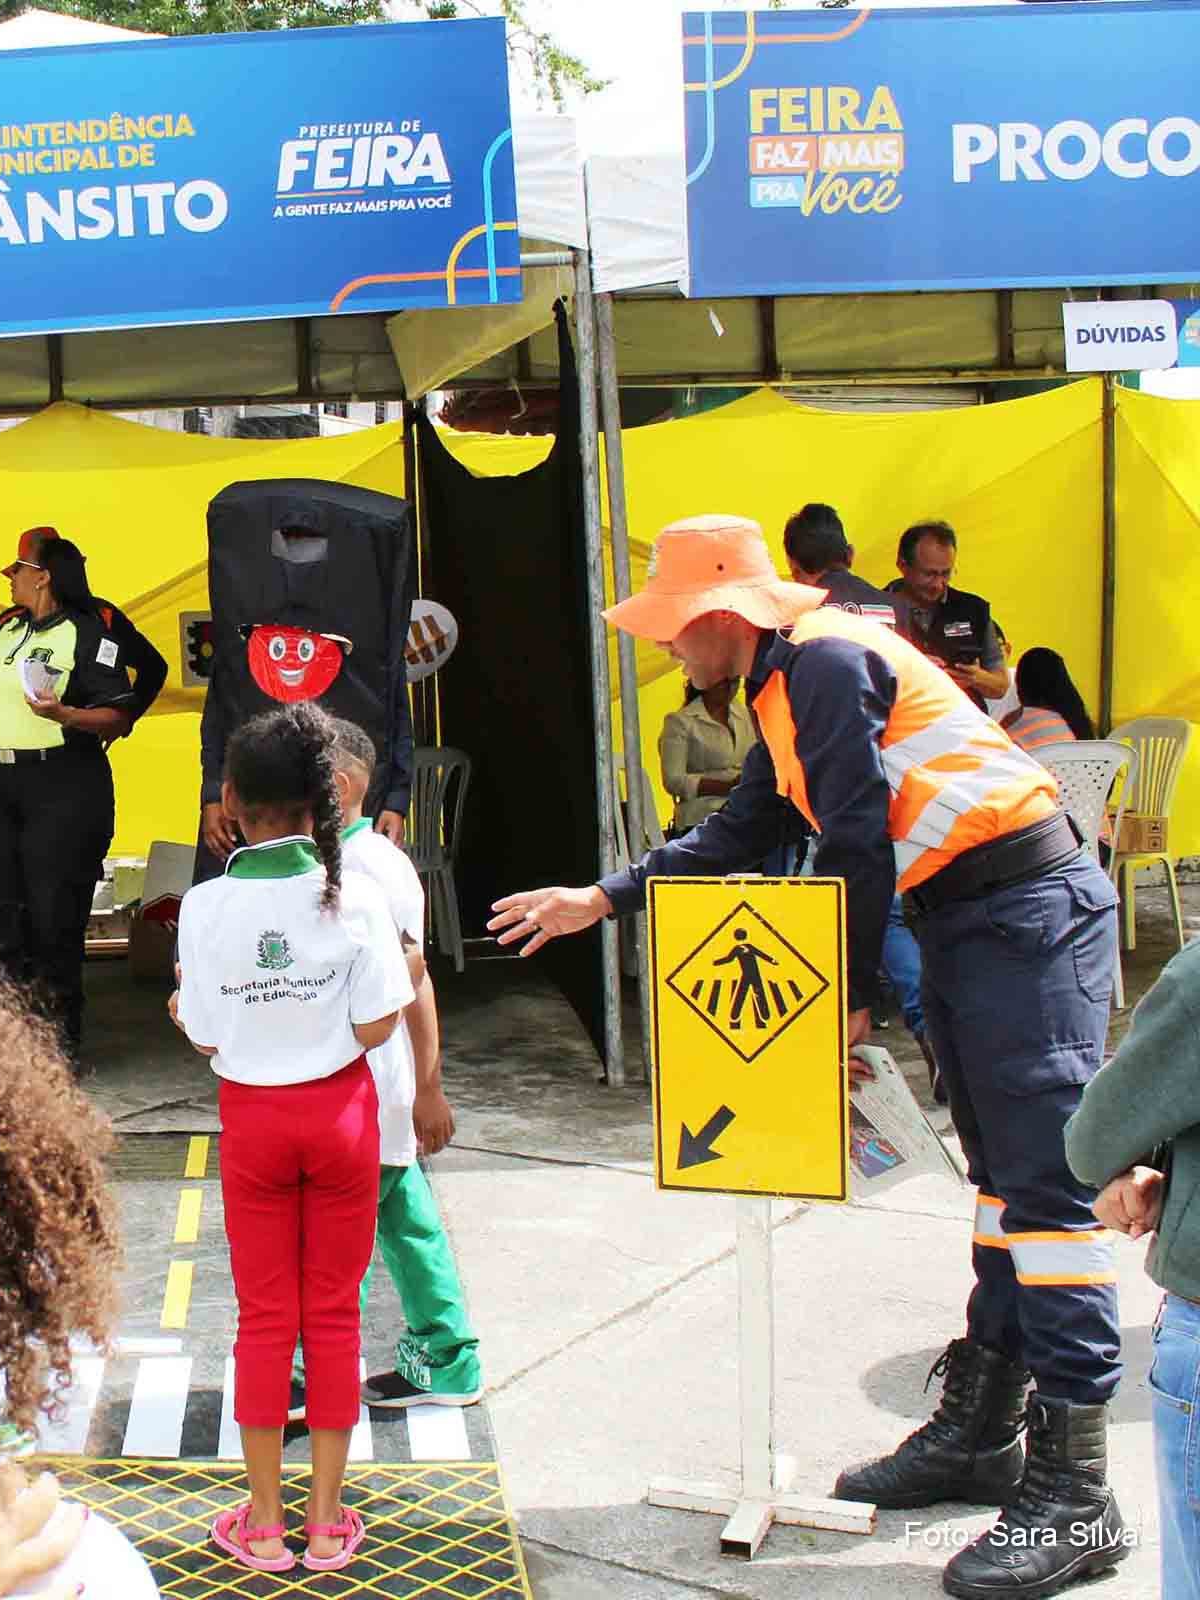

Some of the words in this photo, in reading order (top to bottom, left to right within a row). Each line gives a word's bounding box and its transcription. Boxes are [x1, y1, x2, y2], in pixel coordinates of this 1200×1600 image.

[750, 85, 904, 133] FEIRA
[299, 121, 393, 138] PREFEITURA
[401, 120, 421, 133] DE
[117, 144, 155, 168] DE
[756, 142, 810, 169] FAZ
[823, 140, 899, 167] MAIS
[952, 117, 1200, 183] PROCO
[277, 133, 451, 192] FEIRA
[756, 182, 800, 201] PRA
[274, 206, 284, 217] A
[286, 203, 329, 216] GENTE
[329, 202, 353, 214] FAZ
[354, 200, 389, 213] MAIS
[390, 199, 415, 211] PRA
[417, 194, 452, 209] VOCÊ
[1076, 323, 1166, 344] DÚVIDAS
[220, 977, 280, 996] Secretaria
[244, 993, 260, 1005] de
